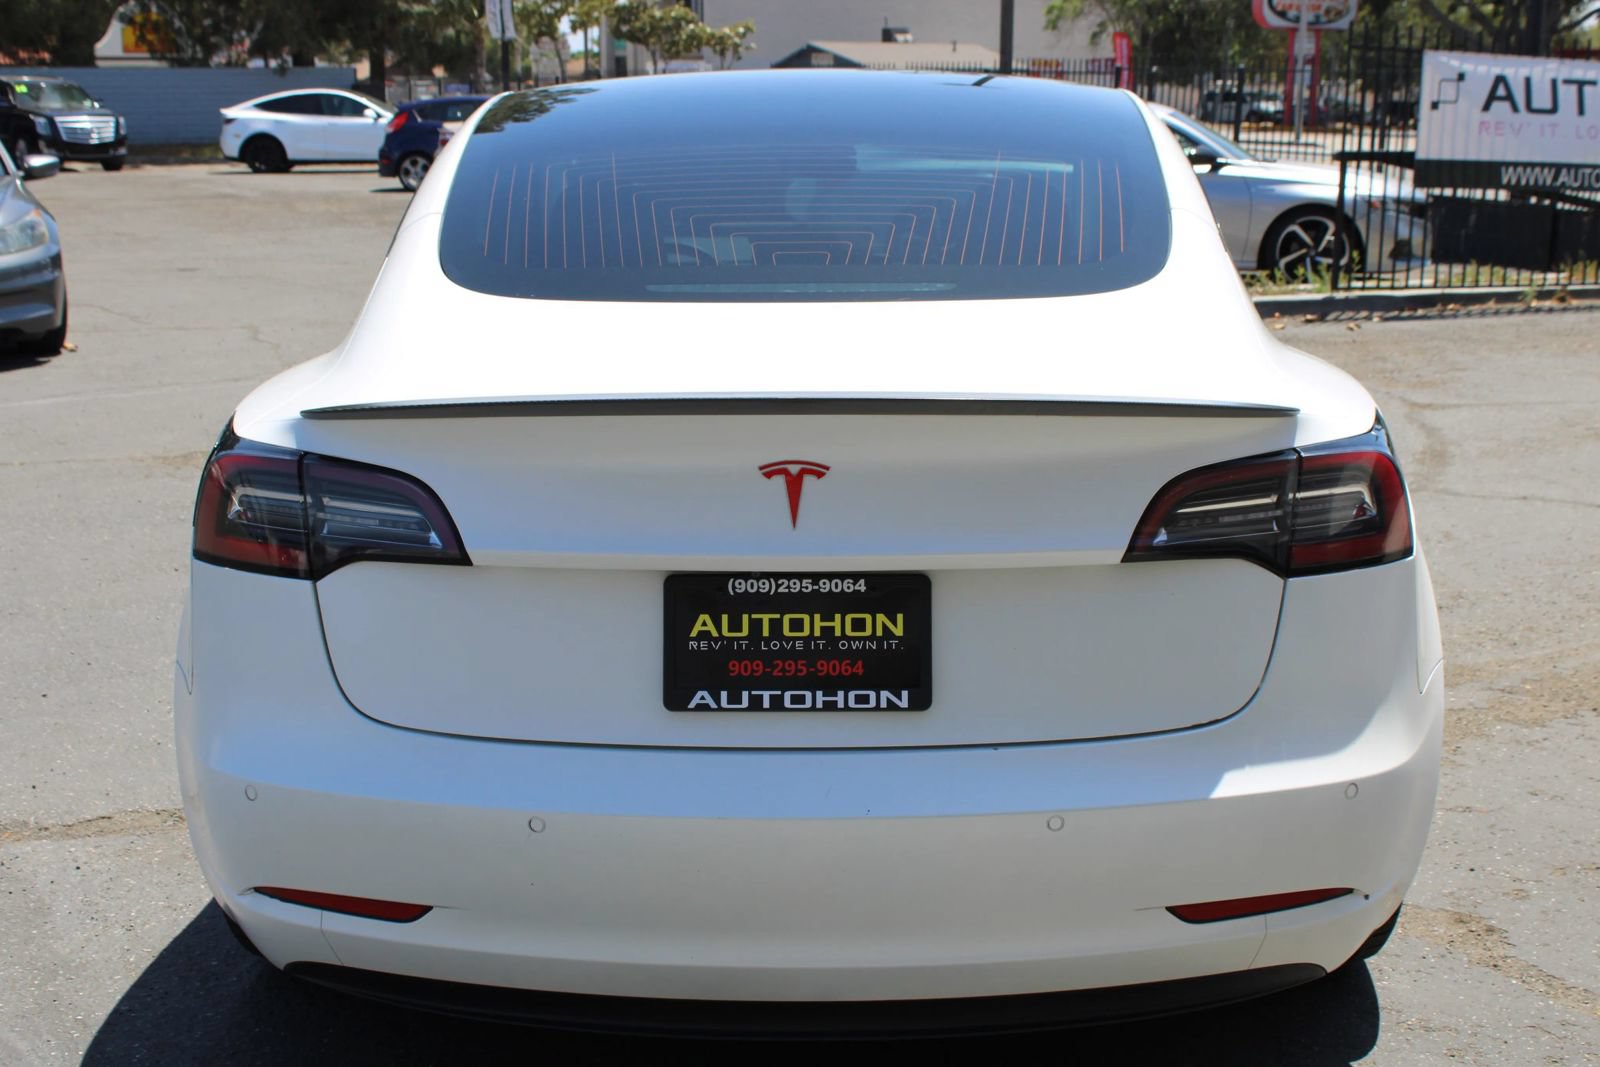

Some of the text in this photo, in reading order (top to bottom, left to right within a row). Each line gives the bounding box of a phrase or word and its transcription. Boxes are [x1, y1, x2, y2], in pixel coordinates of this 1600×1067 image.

[1481, 74, 1598, 116] AUT
[728, 578, 867, 595] (909)295-9064
[689, 613, 904, 637] AUTOHON
[733, 640, 754, 650] IT.
[761, 640, 804, 650] LOVE
[811, 640, 831, 650] IT.
[838, 640, 877, 650] OWN
[883, 640, 904, 650] IT.
[728, 660, 864, 677] 909-295-9064
[687, 690, 909, 709] AUTOHON
